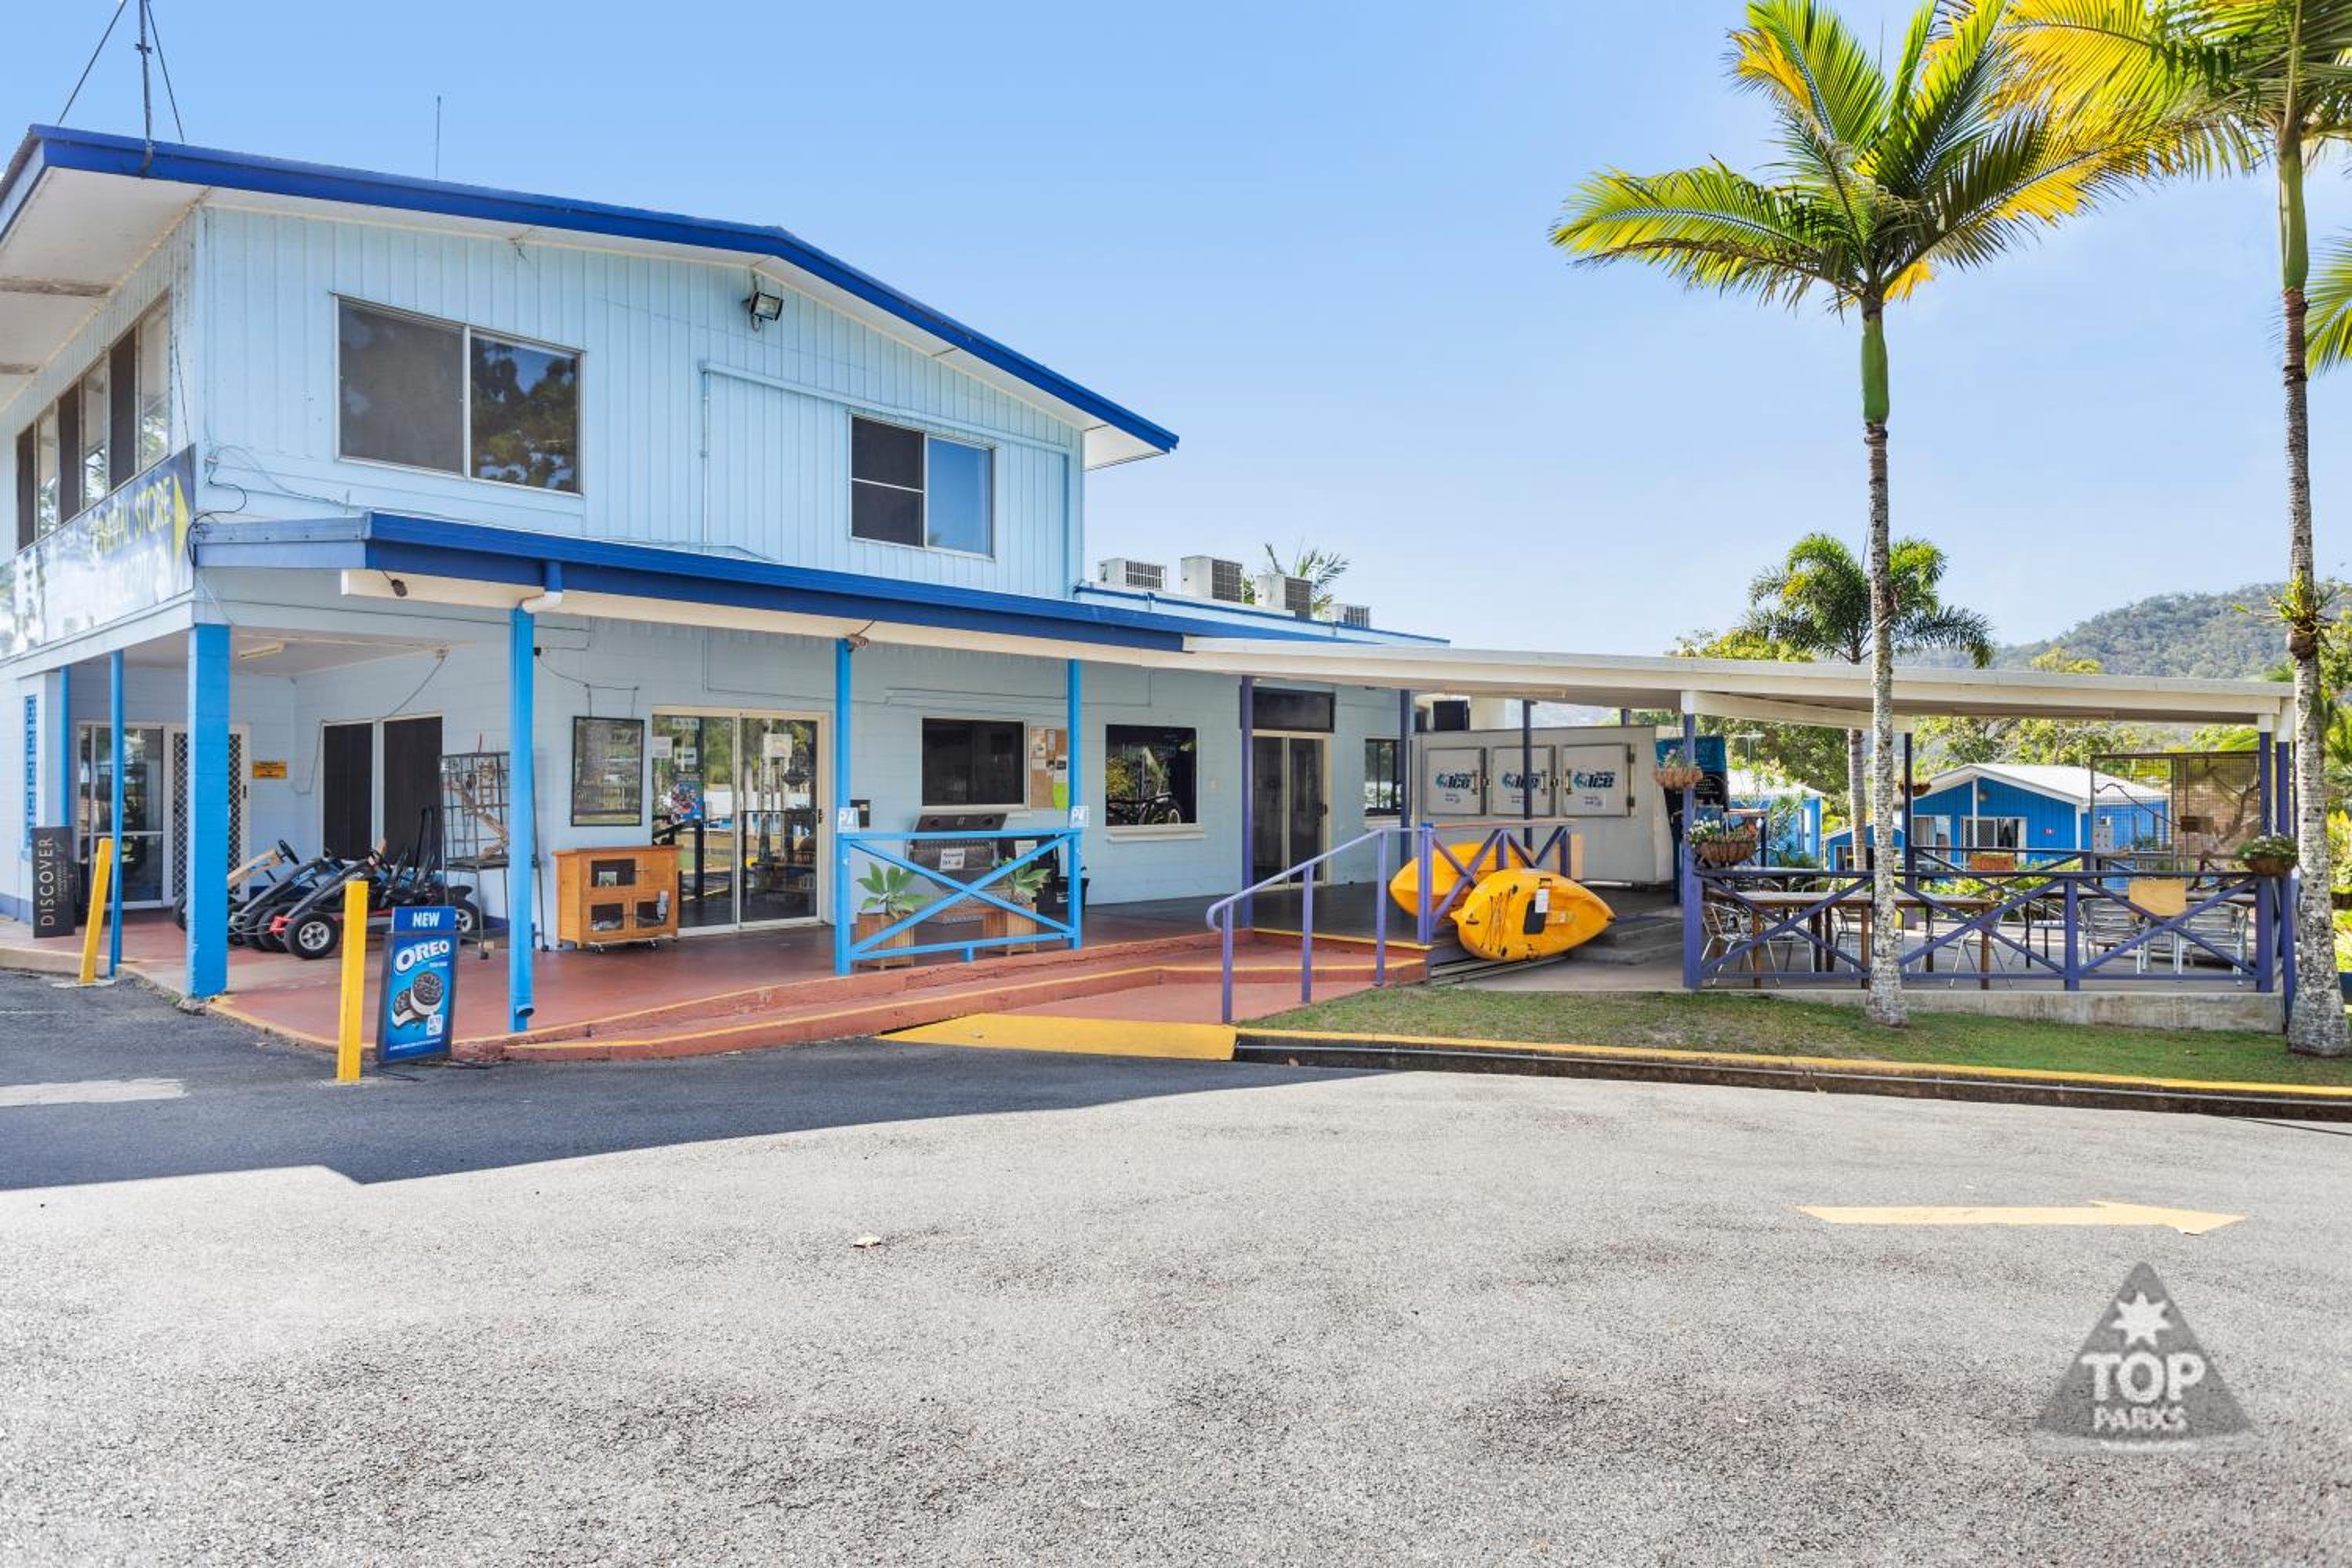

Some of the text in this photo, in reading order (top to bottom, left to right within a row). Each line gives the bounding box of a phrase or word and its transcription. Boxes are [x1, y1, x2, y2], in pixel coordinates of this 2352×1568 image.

[134, 475, 171, 541] STORE
[38, 837, 56, 927] DISCOVER
[412, 912, 440, 927] NEW
[395, 940, 451, 972] OREO
